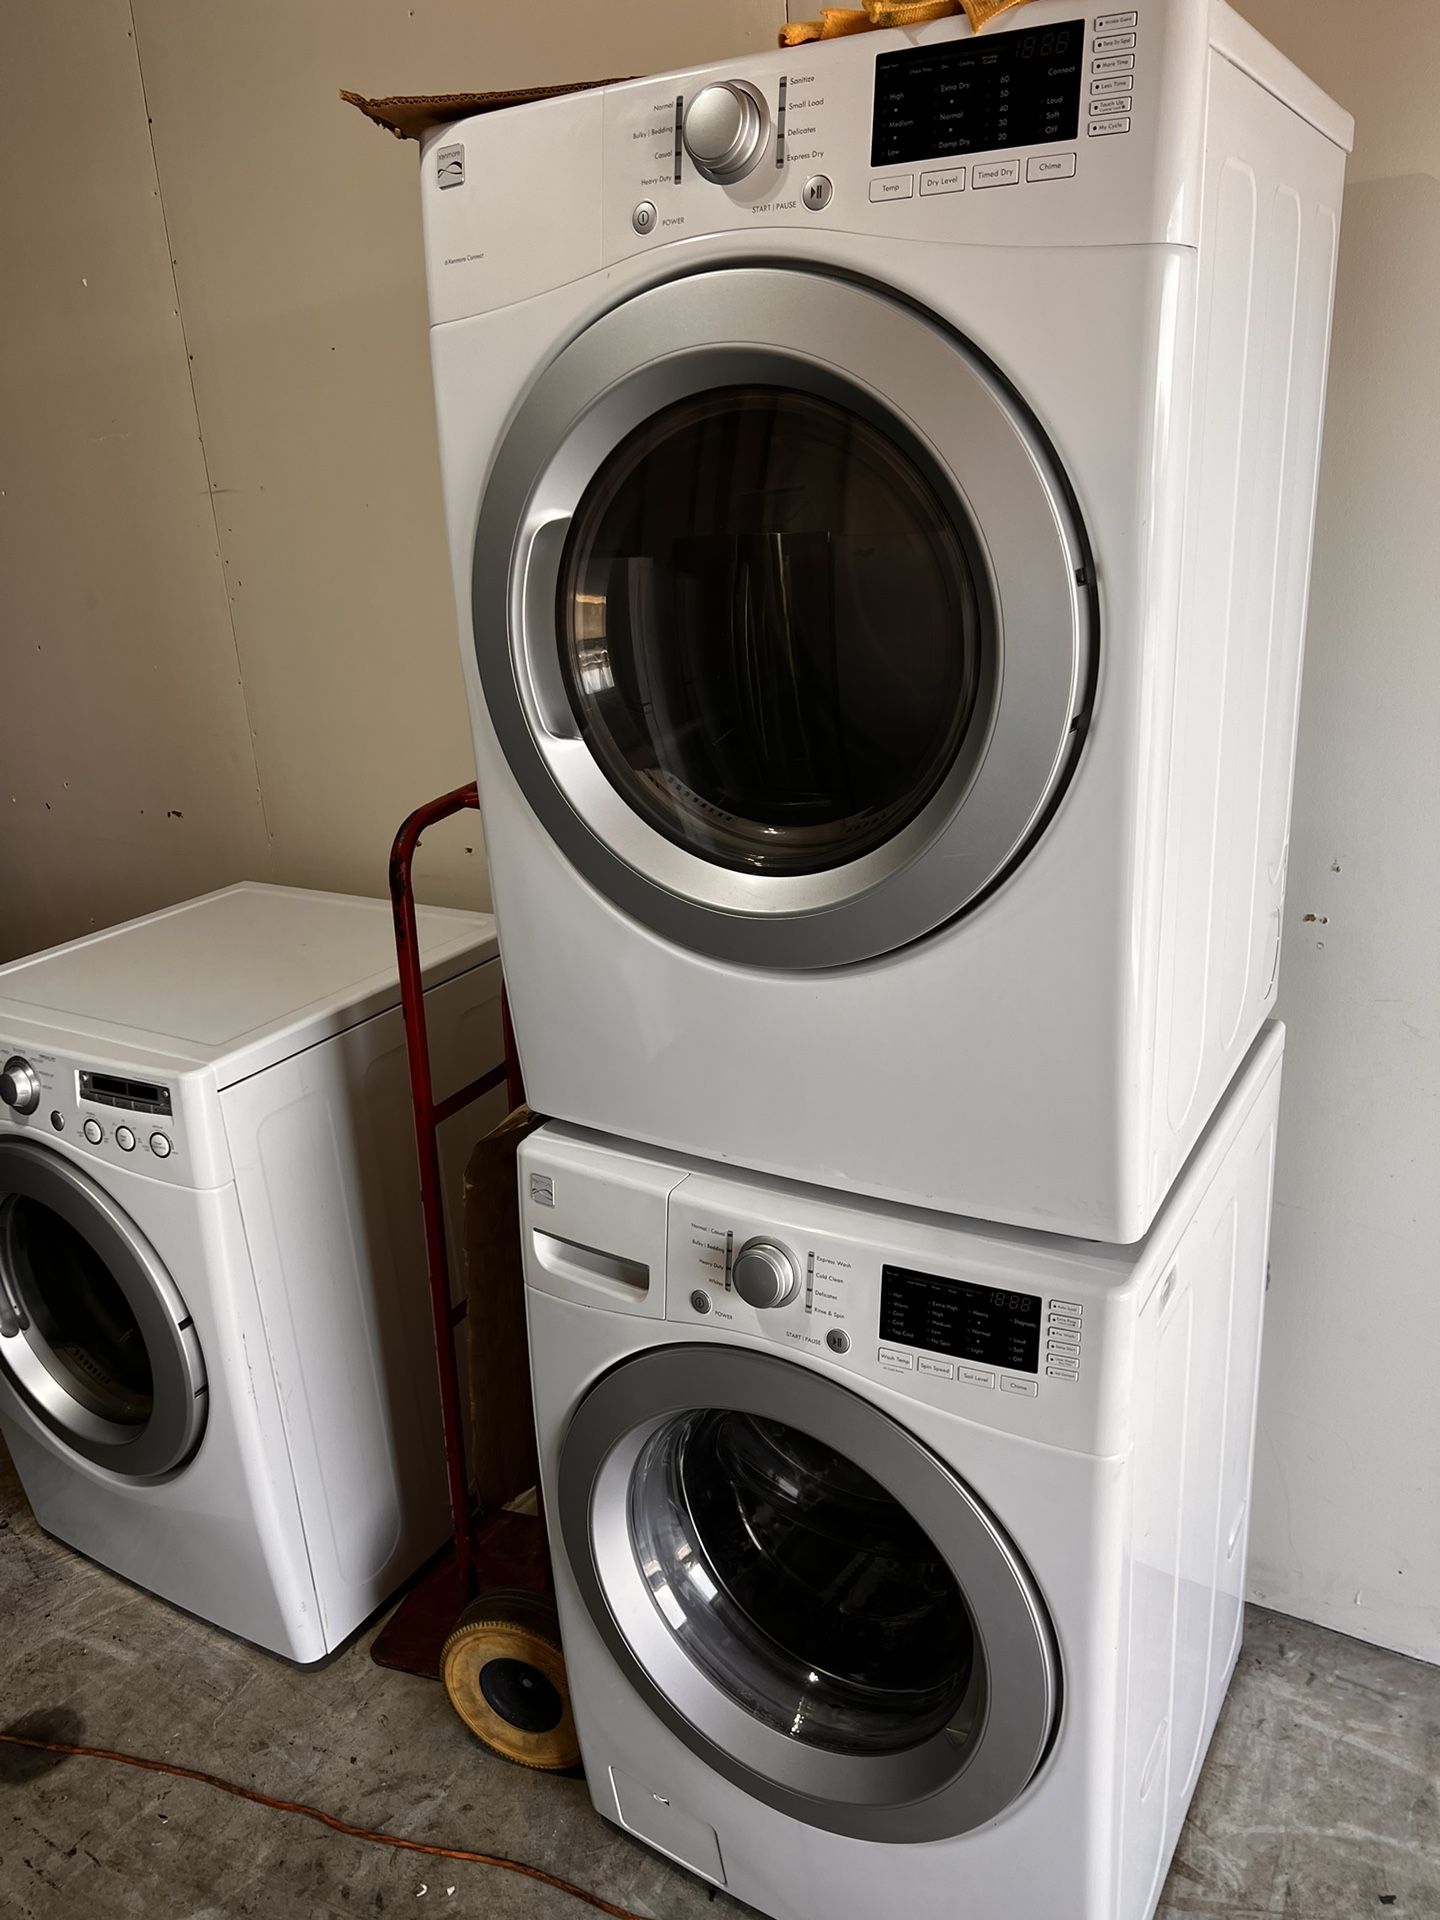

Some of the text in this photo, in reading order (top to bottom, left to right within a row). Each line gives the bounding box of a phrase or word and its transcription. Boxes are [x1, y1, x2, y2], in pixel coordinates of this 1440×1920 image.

[1048, 66, 1075, 76] Connect
[790, 76, 815, 85] Sanitize
[1000, 75, 1010, 83] 60
[959, 82, 970, 90] Dry
[890, 93, 904, 101] High
[1000, 90, 1009, 98] 50
[788, 98, 824, 110] Small Load
[1047, 96, 1063, 104] Loud
[653, 101, 674, 111] Normal
[1000, 104, 1008, 112] 40
[940, 111, 963, 120] Normal
[1046, 111, 1060, 119] Soft
[889, 120, 913, 128] Medium
[999, 119, 1007, 127] 30
[633, 131, 646, 140] Bulky
[651, 126, 673, 136] Bedding
[788, 127, 816, 137] Delicates
[1045, 125, 1058, 134] Off
[998, 133, 1007, 141] 20
[938, 138, 970, 149] Damp Dry
[654, 150, 673, 160] Casual
[786, 150, 824, 162] Express Dry
[1039, 162, 1061, 172] Chime
[978, 168, 1014, 180] Timed Dry
[641, 175, 672, 186] Heavy Duty
[927, 176, 958, 187] Dry Level
[882, 184, 900, 193] Temp
[751, 203, 771, 214] START
[776, 201, 797, 210] PAUSE
[662, 217, 684, 226] POWER
[816, 1256, 835, 1265] Express
[713, 1262, 724, 1270] Duty
[829, 1275, 844, 1283] Clean
[815, 1290, 838, 1300] Delicates
[715, 1310, 733, 1320] POWER
[786, 1331, 801, 1339] START
[805, 1337, 821, 1345] PAUSE
[881, 1353, 911, 1366] Wash Temp
[920, 1362, 950, 1374] Spin Speed
[975, 1375, 988, 1383] Level
